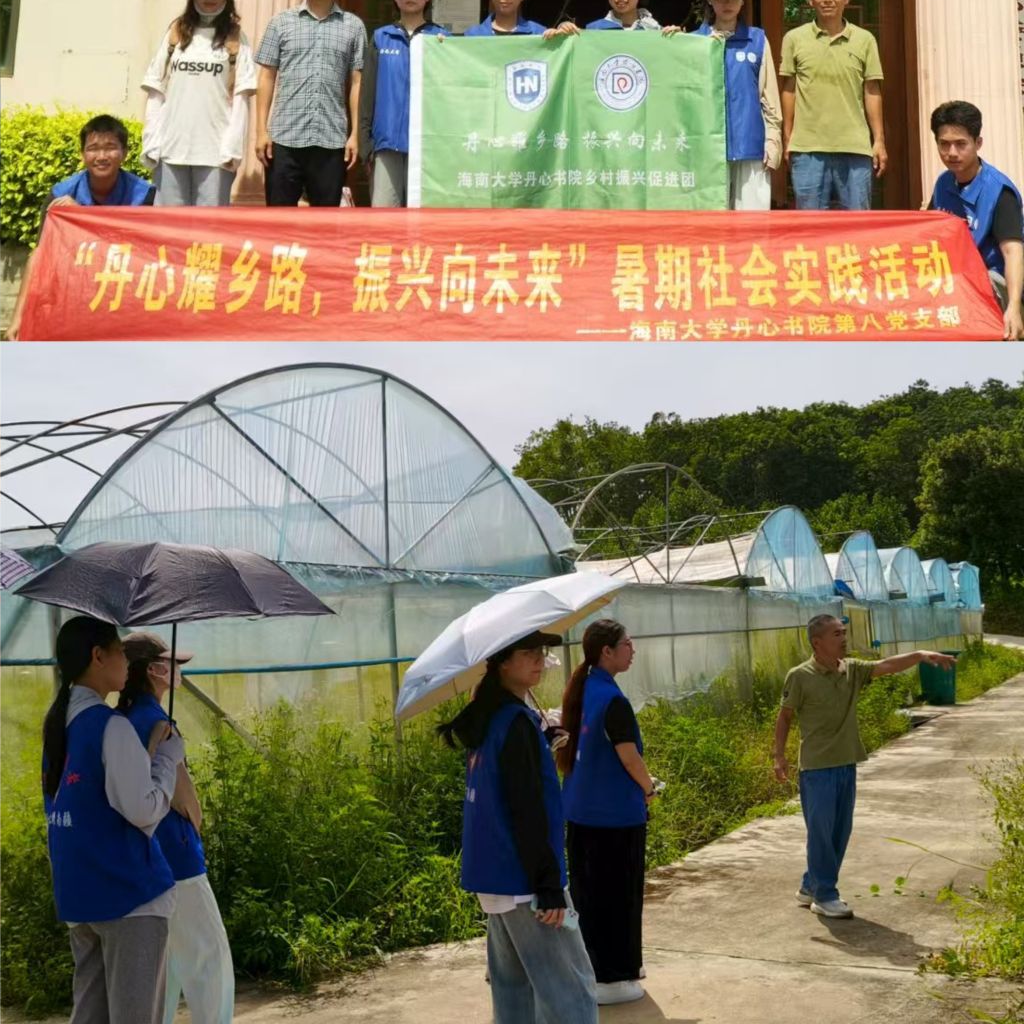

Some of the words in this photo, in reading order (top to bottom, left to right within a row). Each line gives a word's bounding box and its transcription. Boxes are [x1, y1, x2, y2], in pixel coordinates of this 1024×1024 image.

[516, 75, 538, 95] HN
[456, 169, 696, 189] 海南大学丹心书院乡村振兴促进团
